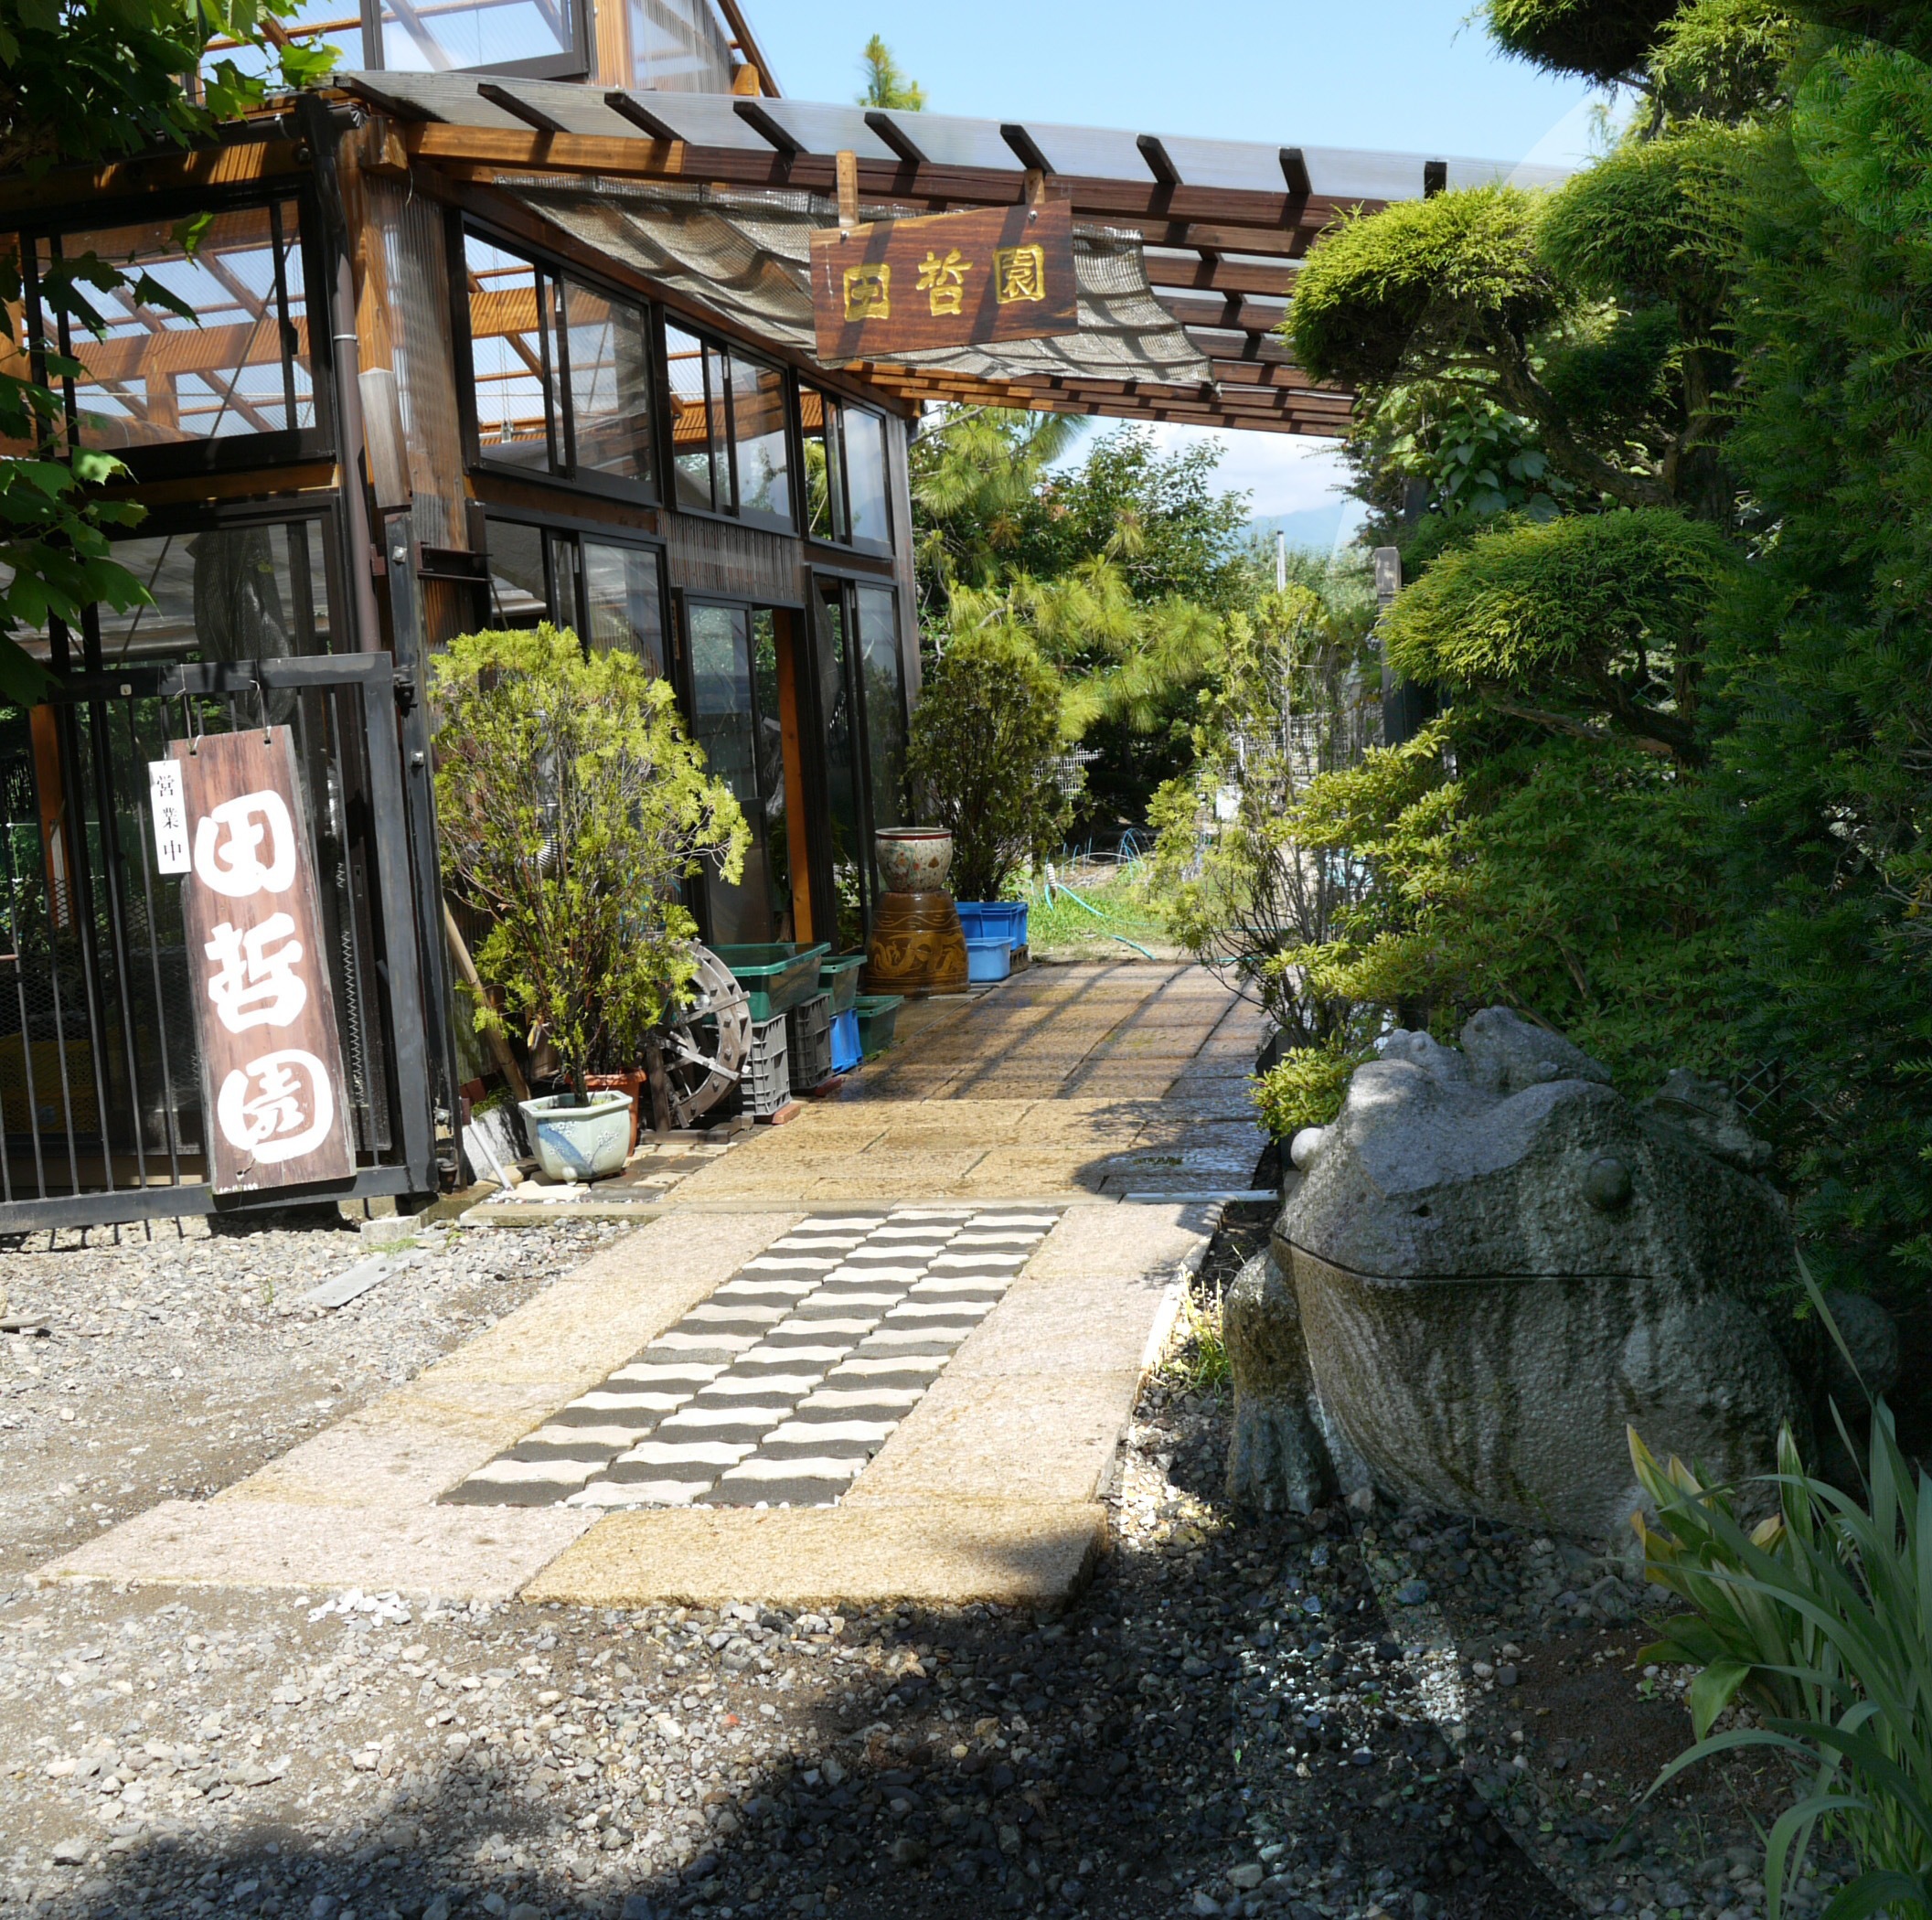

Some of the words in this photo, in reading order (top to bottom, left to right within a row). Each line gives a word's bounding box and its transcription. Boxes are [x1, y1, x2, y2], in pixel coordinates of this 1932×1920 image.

[843, 241, 1046, 322] 田哲園
[156, 774, 182, 861] 営業中
[194, 789, 334, 1164] 田哲園
